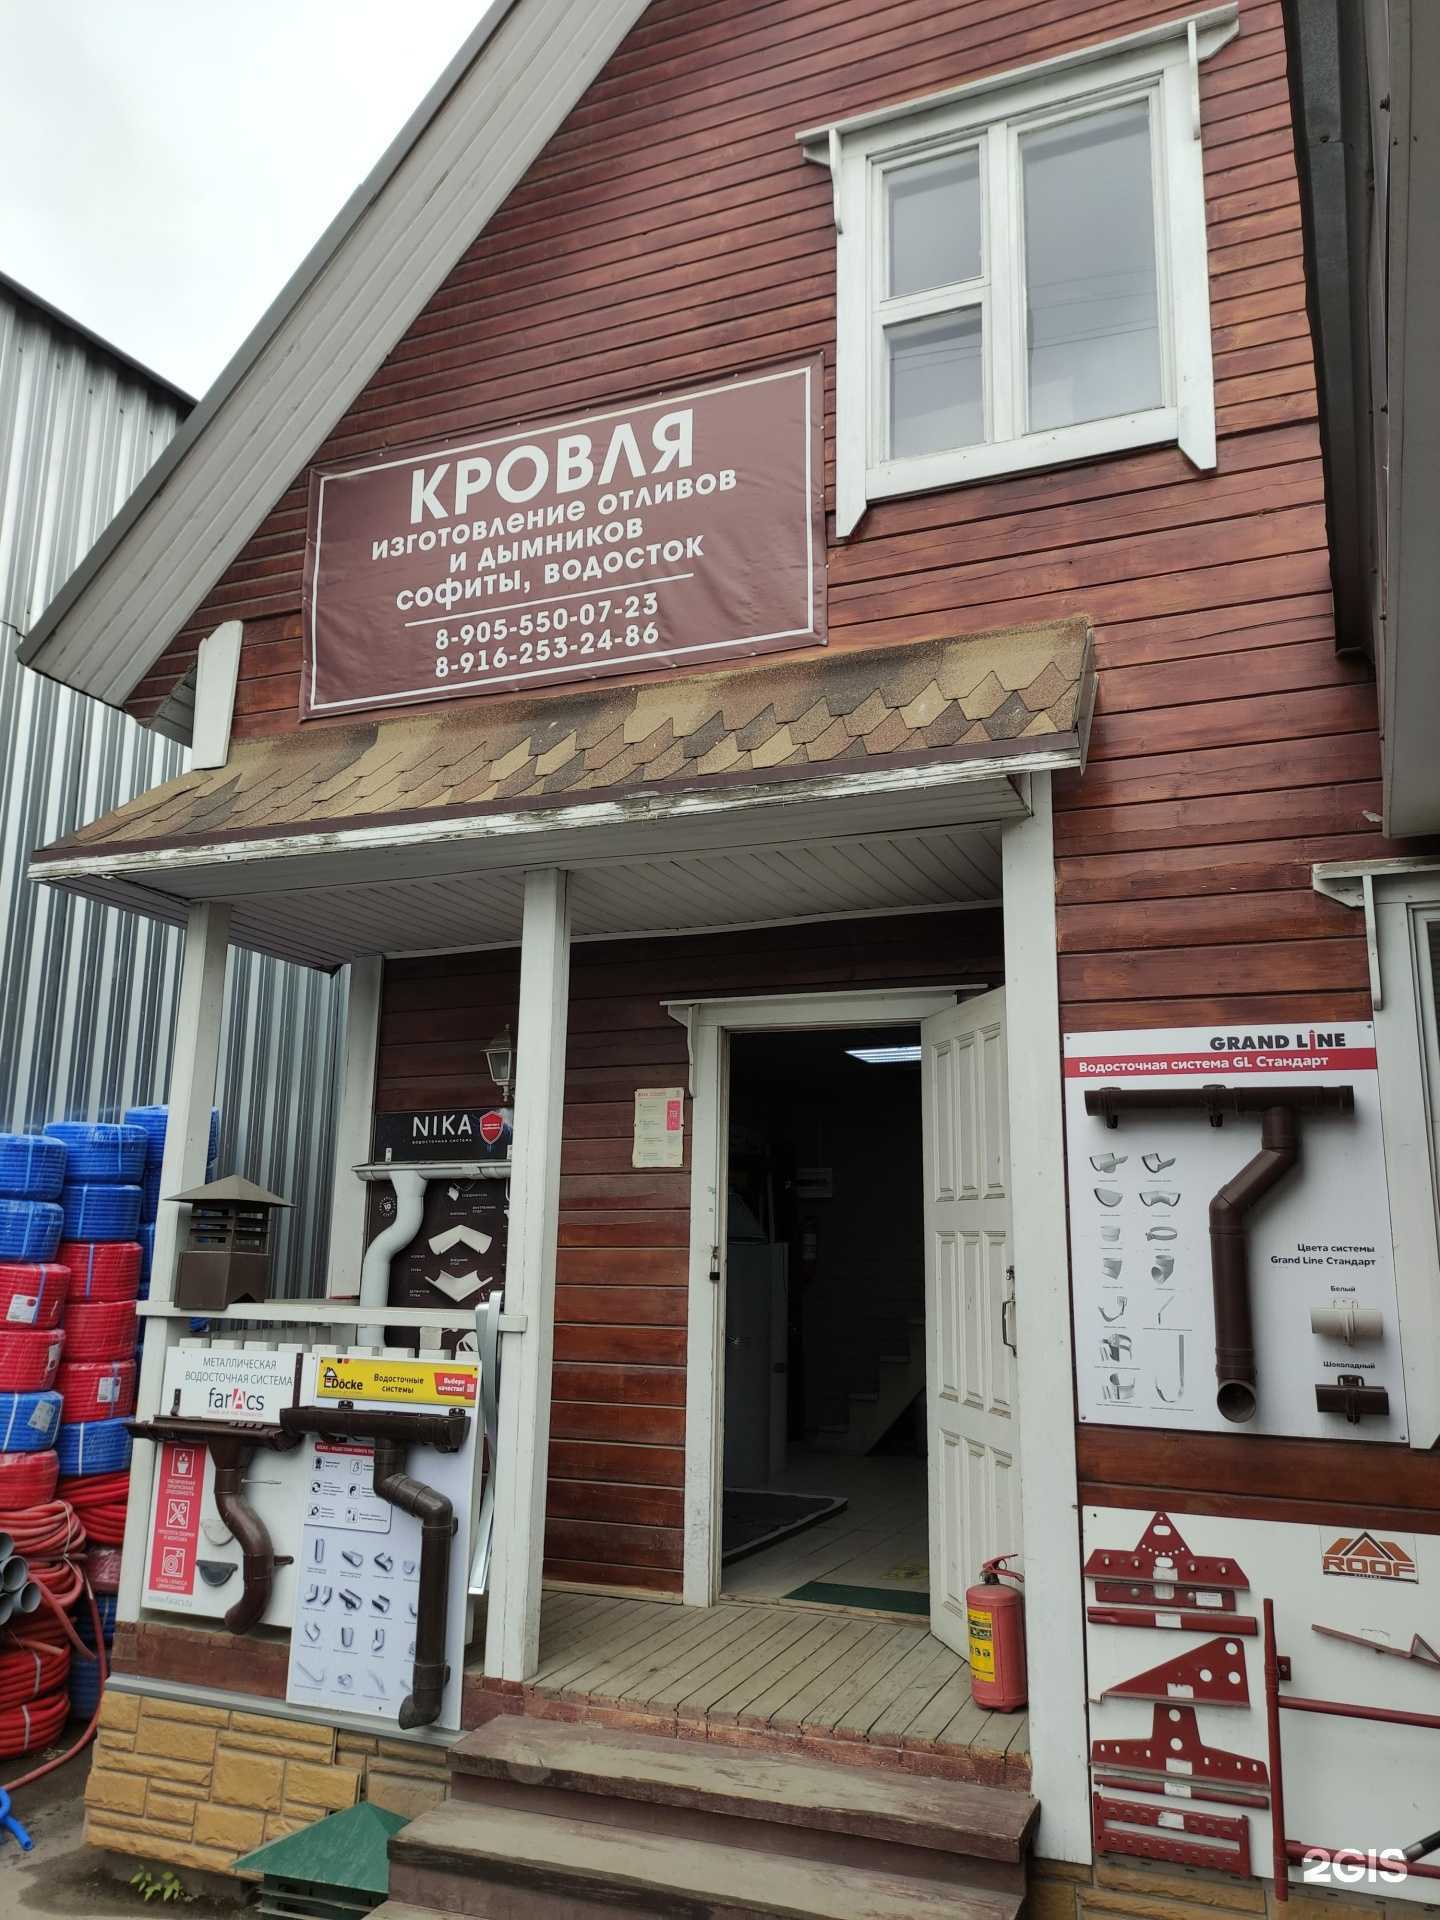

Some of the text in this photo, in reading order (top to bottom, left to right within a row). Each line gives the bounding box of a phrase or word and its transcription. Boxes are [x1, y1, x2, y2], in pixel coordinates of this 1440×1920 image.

[410, 409, 694, 523] КРОВЛЯ
[436, 592, 659, 650] 8-905-550-07-23
[435, 622, 660, 678] 8-916-253-24-86
[1210, 1035, 1289, 1051] GRAND
[1079, 1055, 1329, 1073] Водосточная система GL Стандарт
[412, 1114, 472, 1137] NIKA
[1297, 1243, 1328, 1252] Цвета
[1271, 1256, 1300, 1264] Grand
[1326, 1257, 1376, 1267] Стандарт
[203, 1357, 276, 1369] МЕТАЛЛИЧЕСКАЯ
[185, 1372, 293, 1386] ВОДОСТОЧНАЯ СИСТЕМА
[331, 1378, 363, 1390] Döcke
[373, 1374, 424, 1385] Водосточные
[382, 1386, 414, 1394] системы
[1323, 1555, 1415, 1576] ROOF
